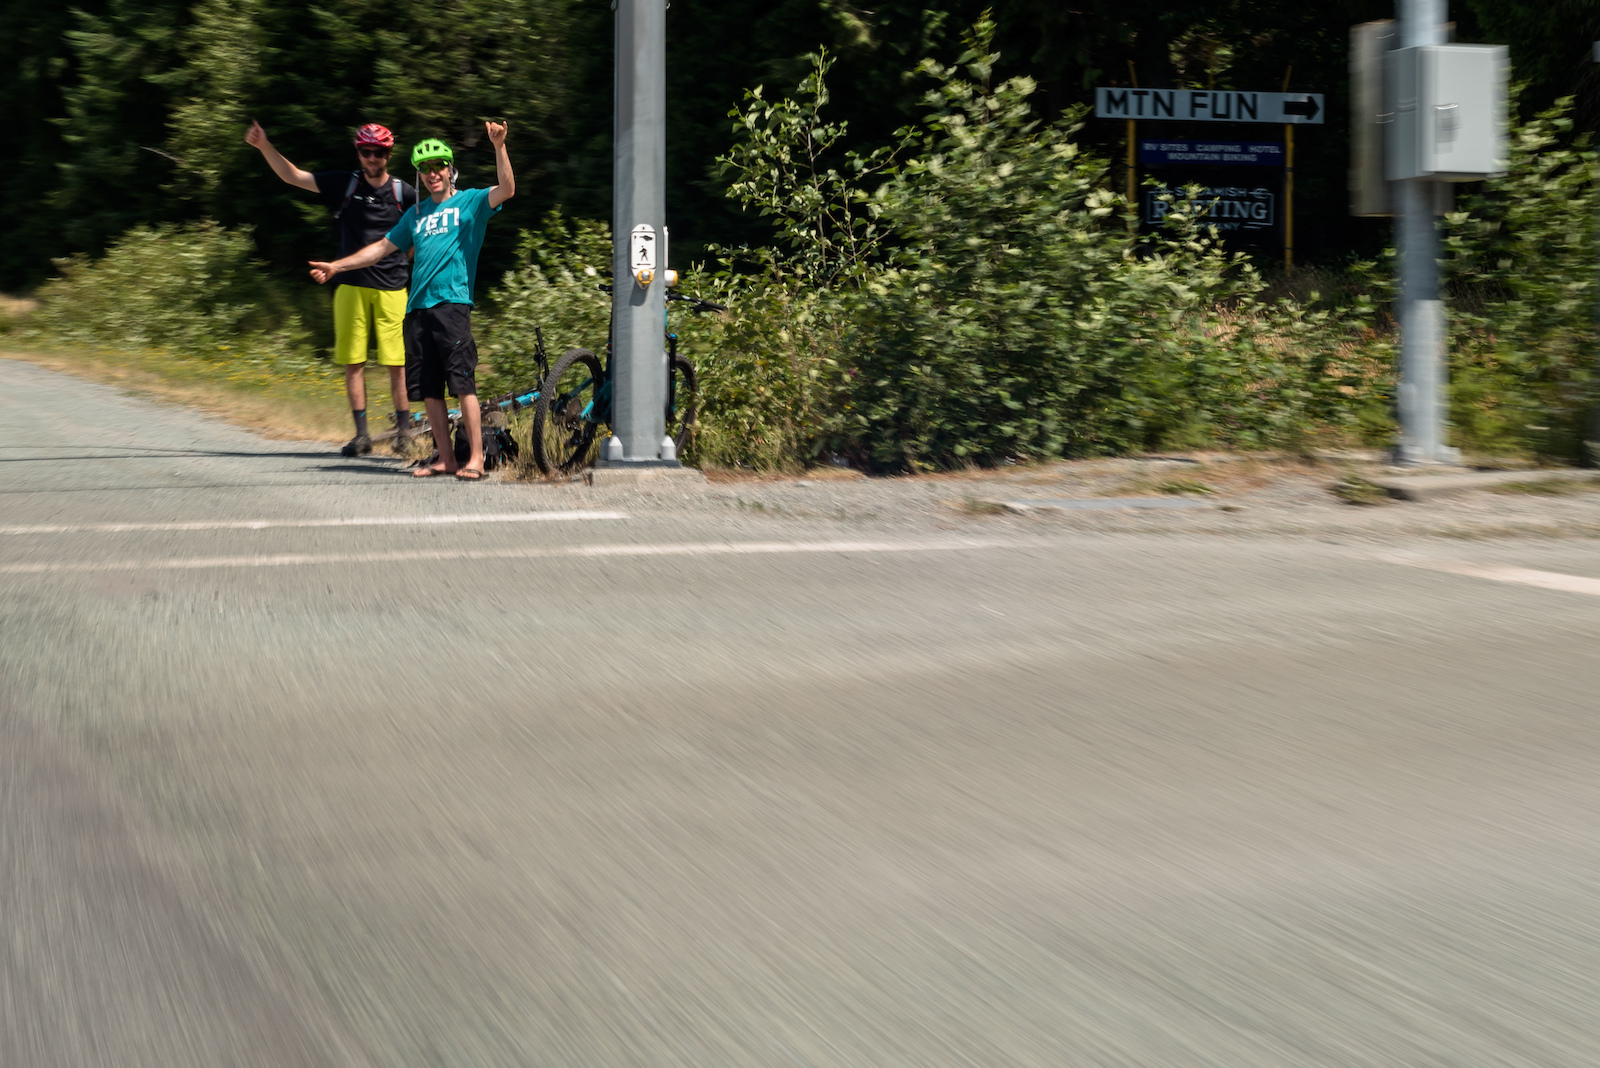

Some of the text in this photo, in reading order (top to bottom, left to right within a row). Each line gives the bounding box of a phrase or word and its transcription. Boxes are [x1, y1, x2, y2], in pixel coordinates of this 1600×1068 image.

[1106, 89, 1257, 120] MTN FUN
[1143, 142, 1281, 154] RV SITES CAMPING HOTEL
[1167, 152, 1258, 162] MOUNTAIN BIKING
[1152, 200, 1268, 220] RFTING
[415, 207, 460, 234] YETI
